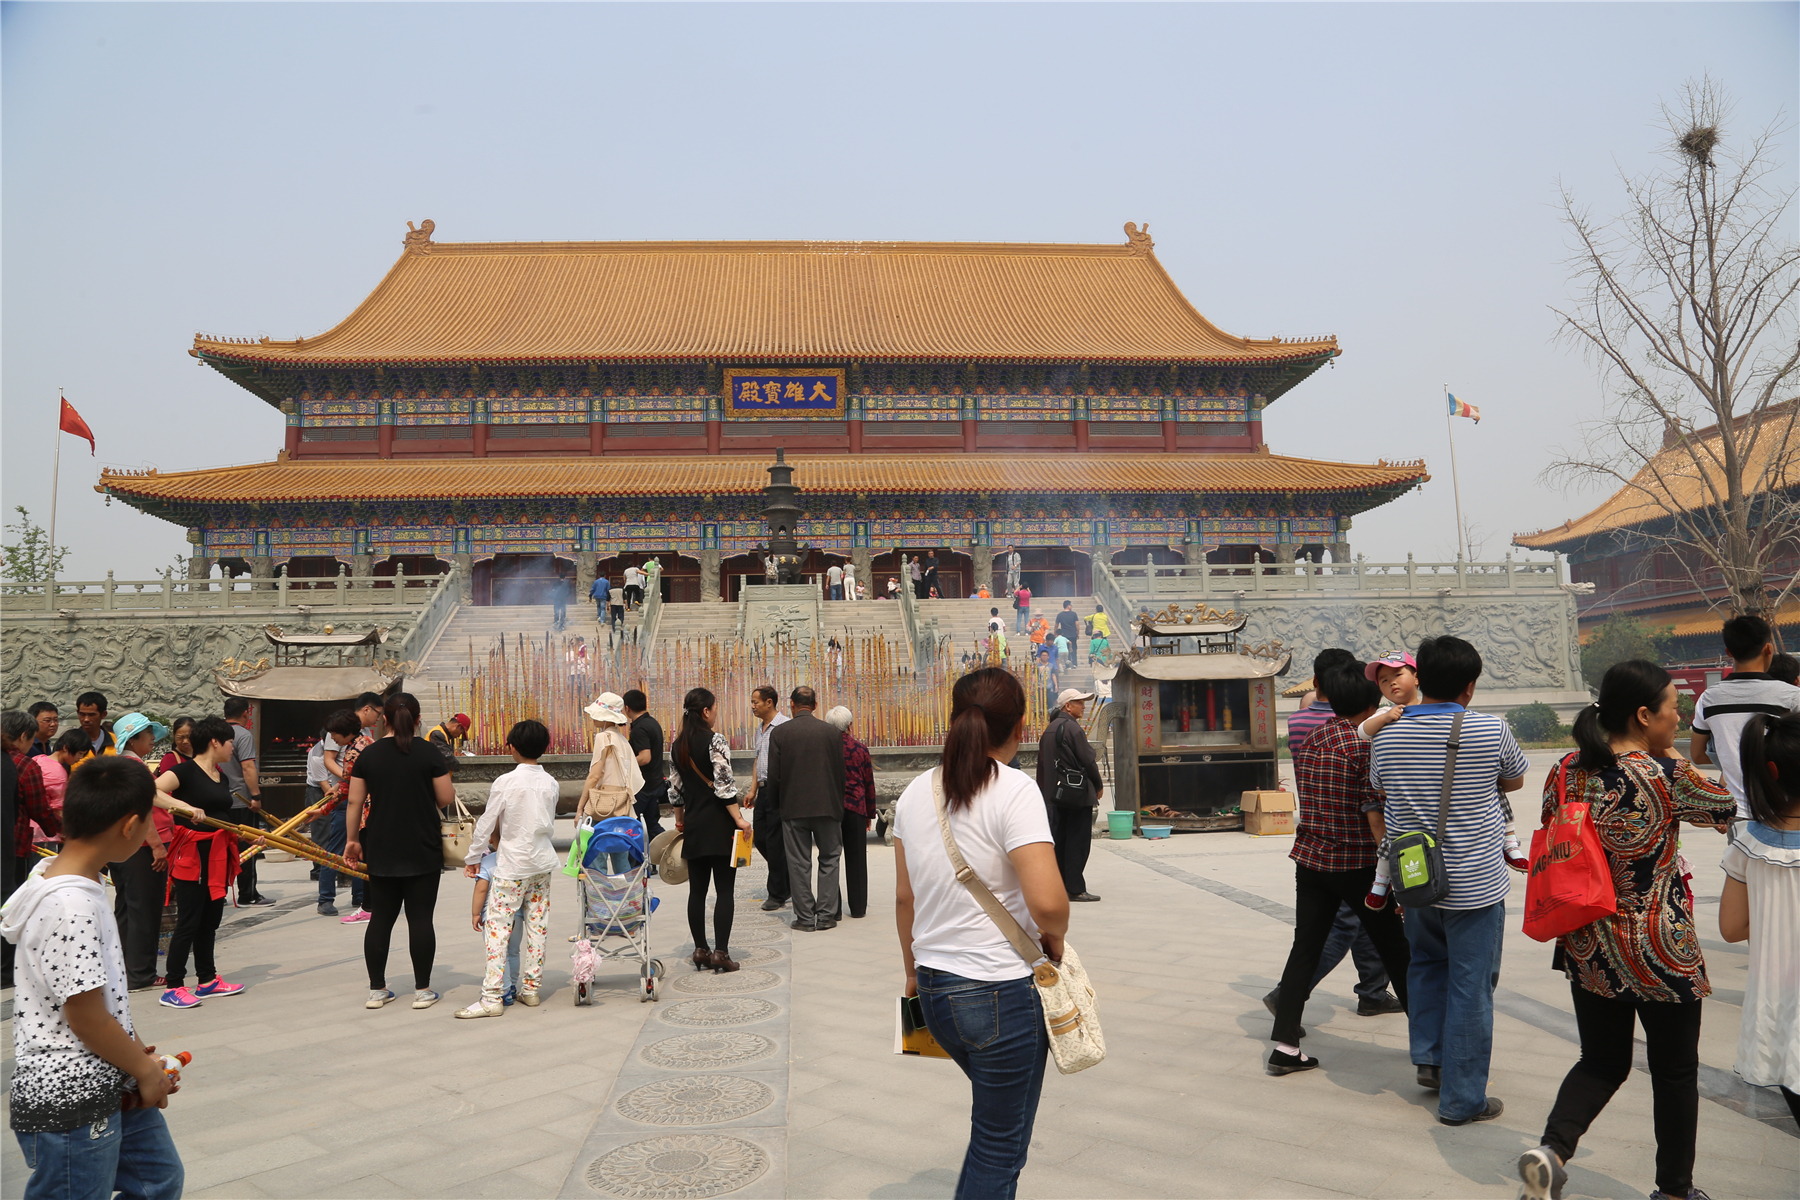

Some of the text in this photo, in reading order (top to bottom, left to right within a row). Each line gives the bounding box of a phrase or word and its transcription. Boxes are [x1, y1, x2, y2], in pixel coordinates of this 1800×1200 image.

[738, 380, 833, 405] 大雄寶殿
[1407, 871, 1422, 879] adidas
